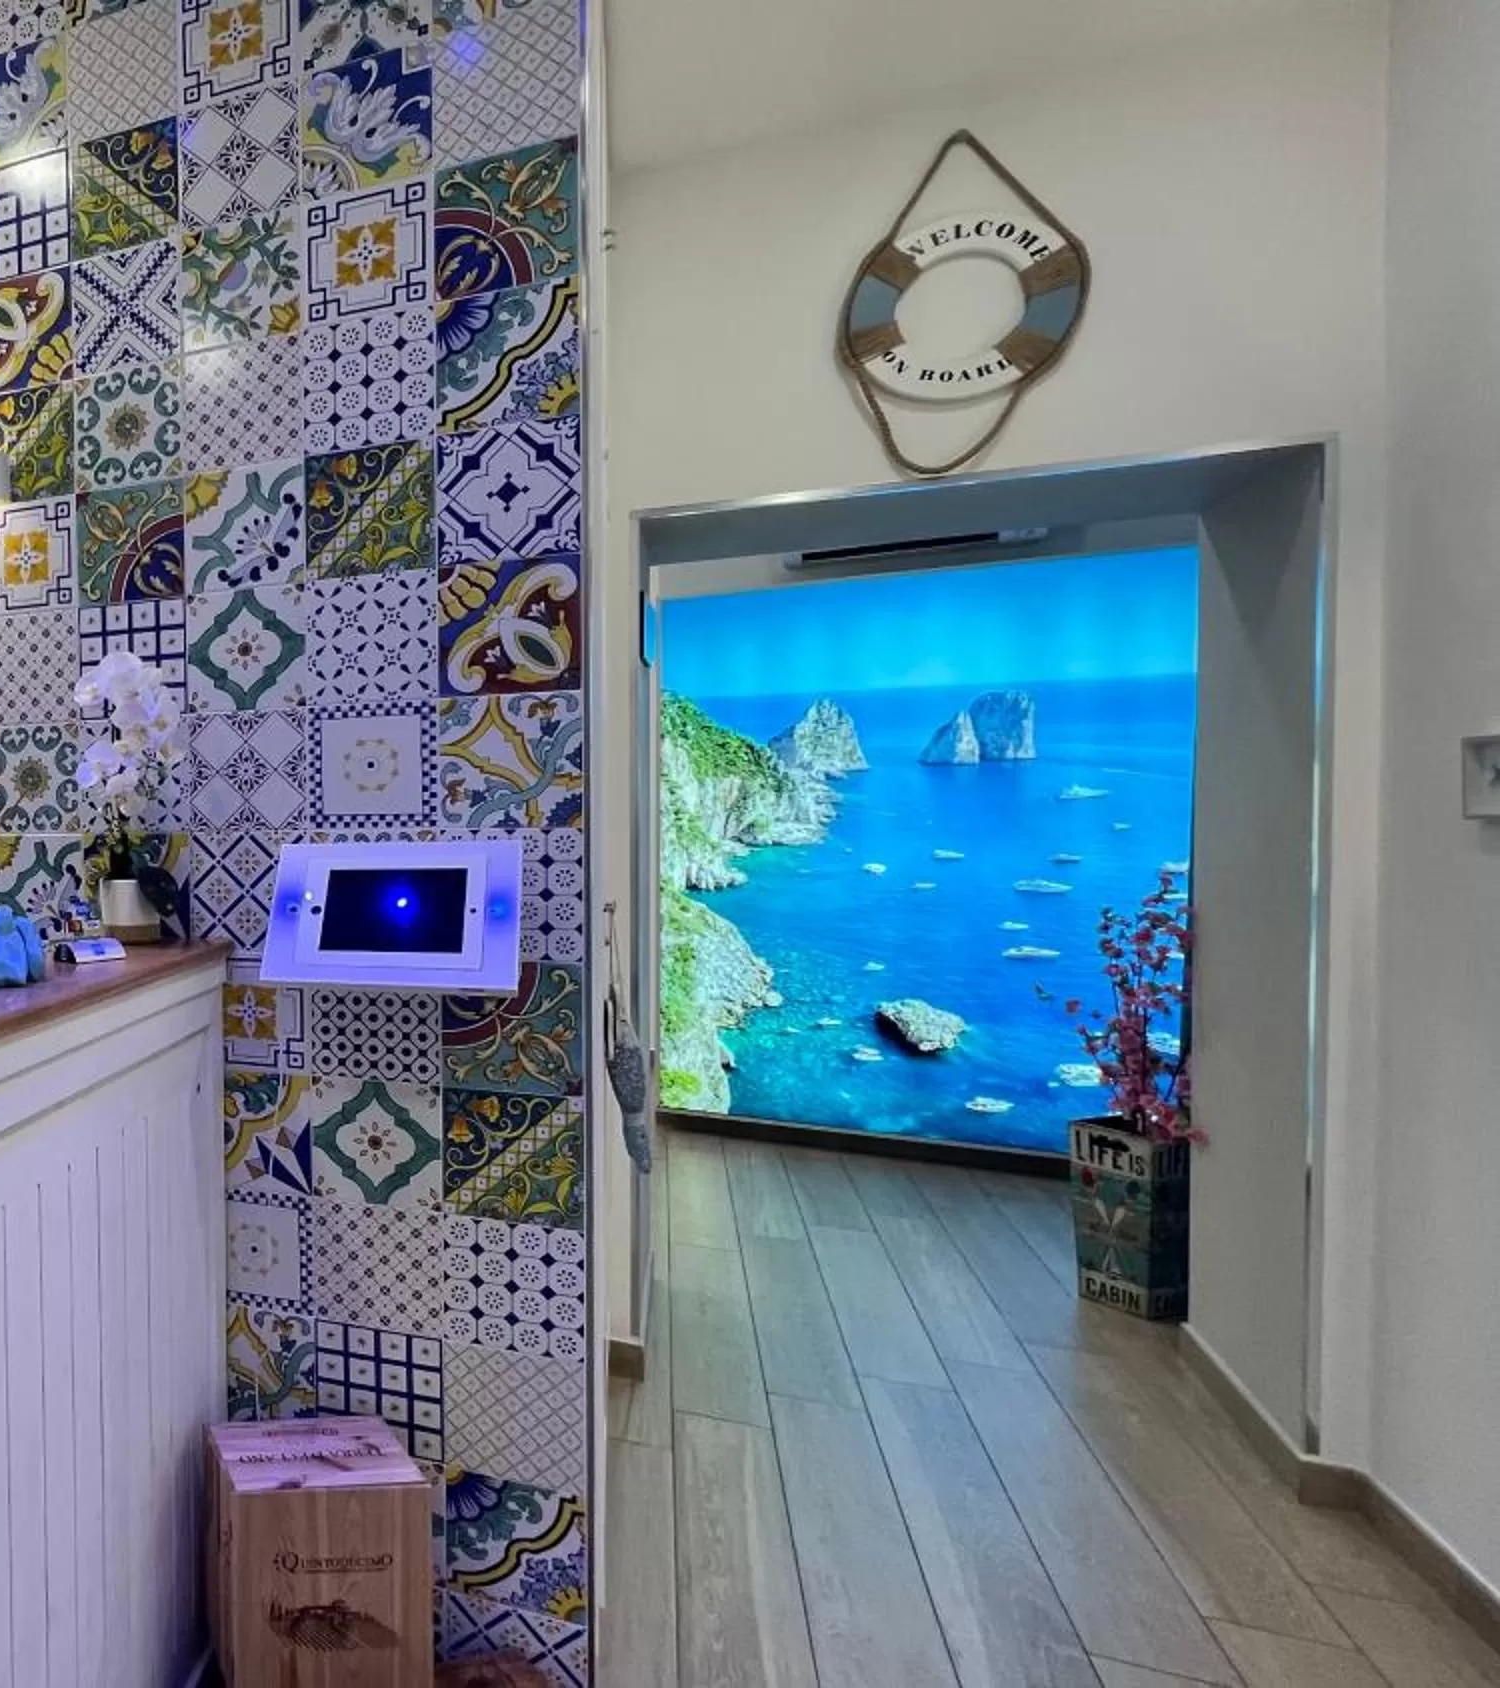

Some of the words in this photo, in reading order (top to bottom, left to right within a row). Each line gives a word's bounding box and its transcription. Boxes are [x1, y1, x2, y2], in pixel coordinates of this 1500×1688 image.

[906, 219, 1052, 262] WELCOME
[882, 351, 909, 375] ON
[918, 357, 1013, 383] BOARD
[1129, 1156, 1146, 1177] IS
[1085, 1277, 1141, 1311] CABIN
